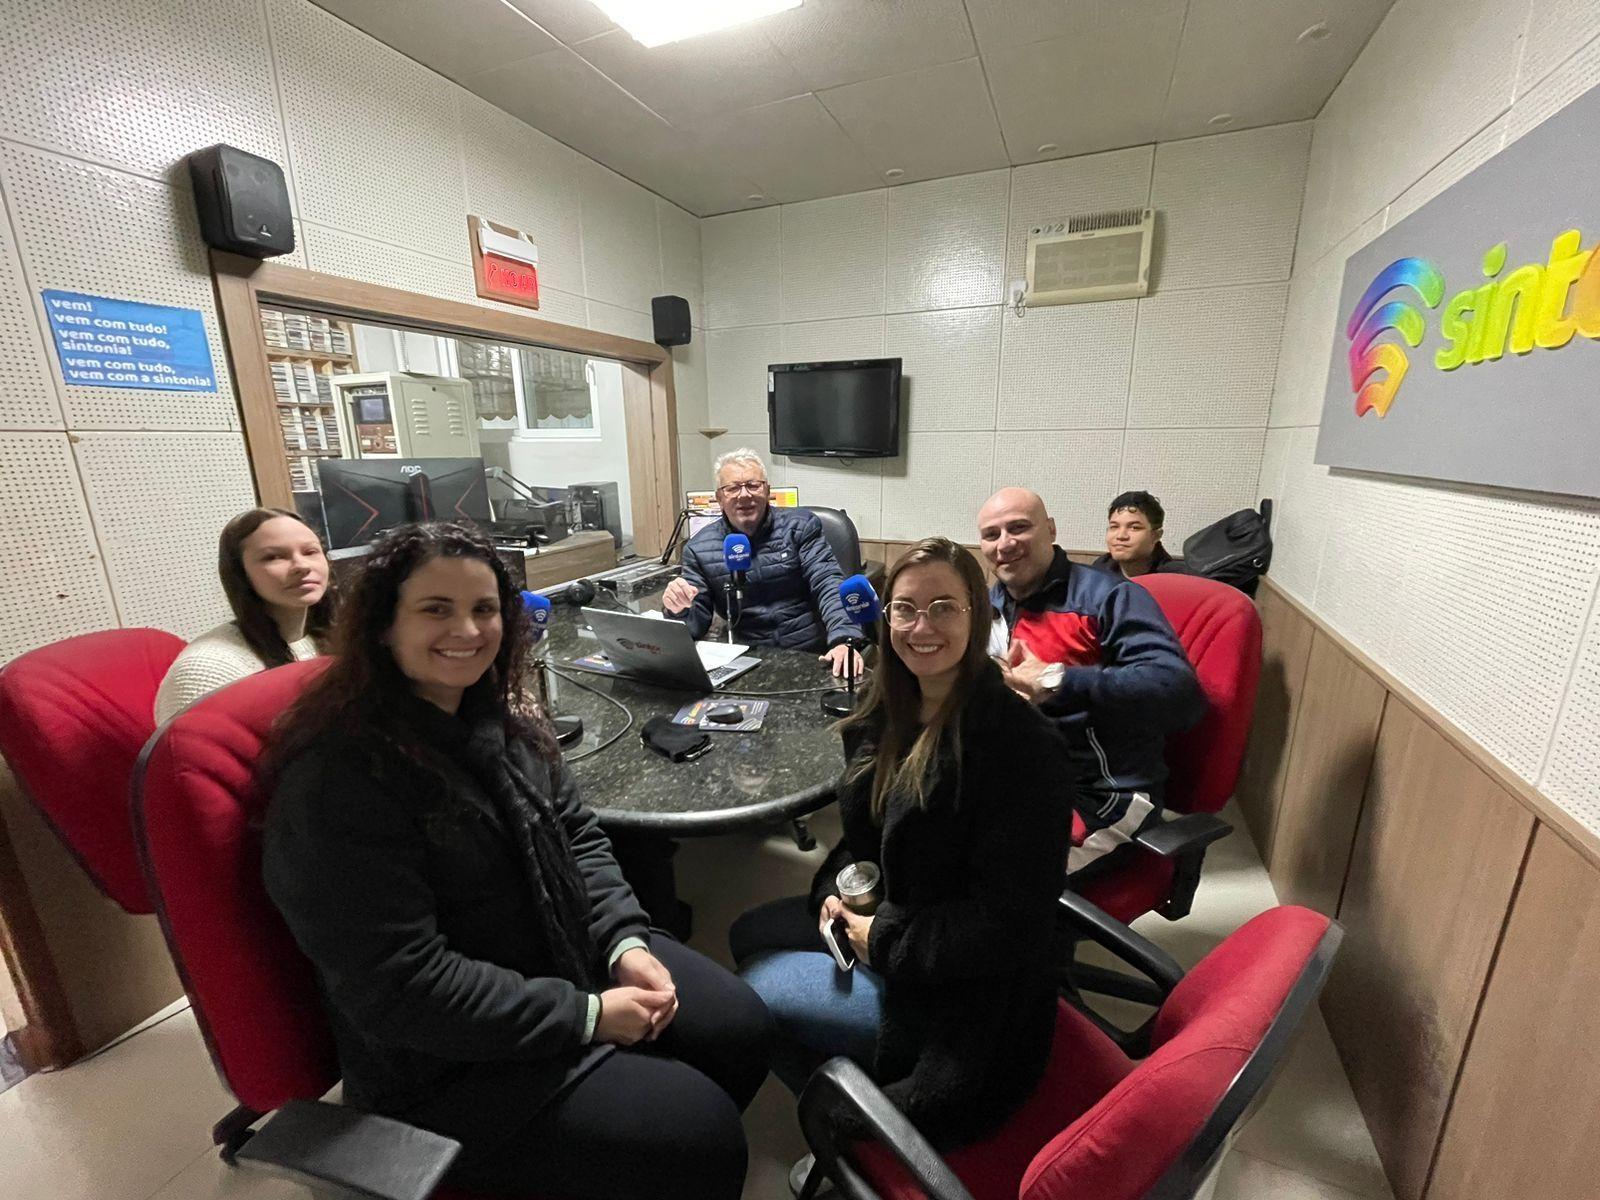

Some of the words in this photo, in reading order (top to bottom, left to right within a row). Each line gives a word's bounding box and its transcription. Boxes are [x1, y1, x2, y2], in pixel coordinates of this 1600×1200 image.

[51, 299, 92, 312] vem!
[54, 314, 91, 325] vem
[93, 318, 127, 330] com
[127, 321, 168, 335] tudo!
[58, 329, 95, 341] vem
[96, 333, 130, 344] com
[131, 336, 171, 350] tudo,
[61, 340, 133, 355] sintonia!
[65, 357, 102, 369] vem
[103, 360, 137, 371] com
[138, 362, 176, 375] tudo,
[68, 369, 105, 381] vem
[106, 372, 139, 383] com
[140, 374, 151, 383] a
[152, 374, 211, 386] sintonia!
